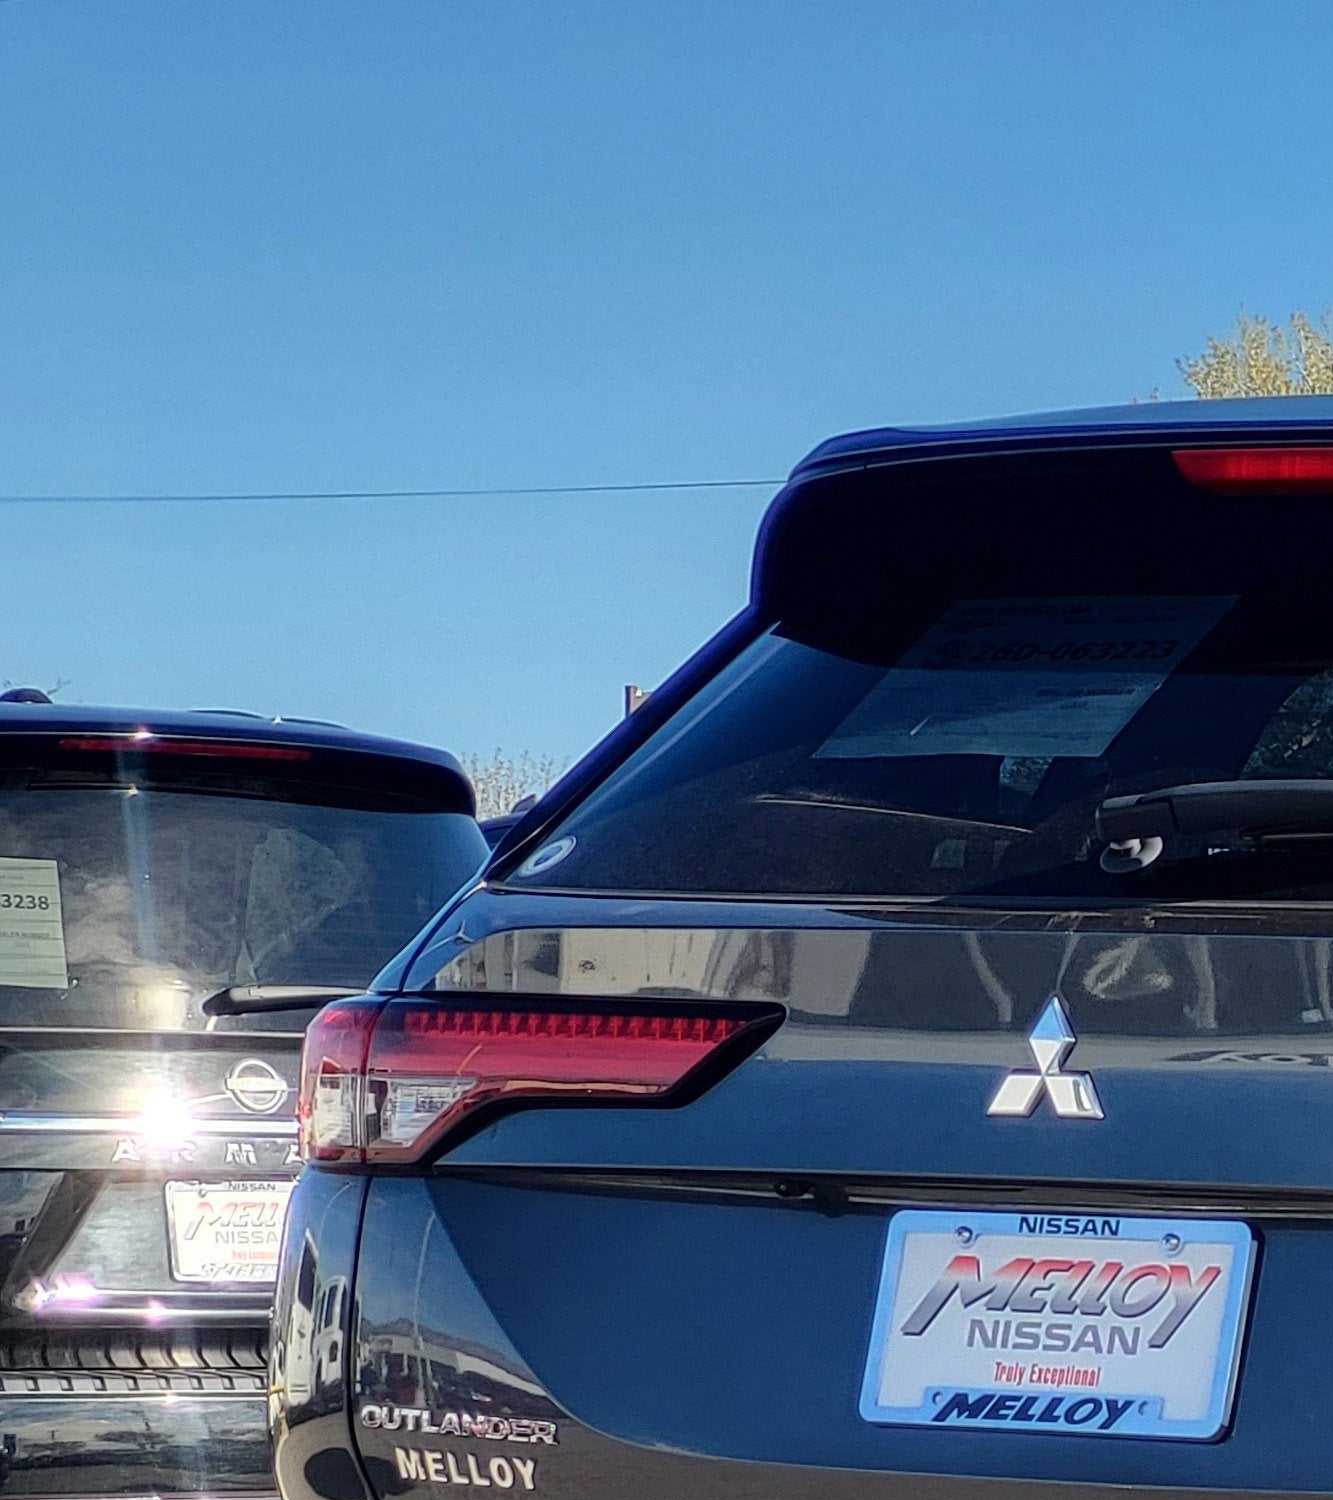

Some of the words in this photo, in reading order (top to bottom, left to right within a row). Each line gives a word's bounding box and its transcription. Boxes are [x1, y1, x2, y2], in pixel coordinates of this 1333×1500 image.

[0, 894, 49, 910] 3238
[228, 1182, 276, 1192] NISSAN
[184, 1202, 280, 1241] MELL
[215, 1230, 279, 1244] NISSA
[1019, 1216, 1120, 1237] NISSAN
[902, 1255, 1222, 1349] MELLOY
[966, 1319, 1141, 1355] NISSAN
[994, 1362, 1025, 1386] Truly
[1030, 1364, 1101, 1388] Exceptional
[361, 1405, 560, 1445] OUTLANDER
[933, 1392, 1134, 1430] MELLOY
[395, 1447, 537, 1491] MELLOY
